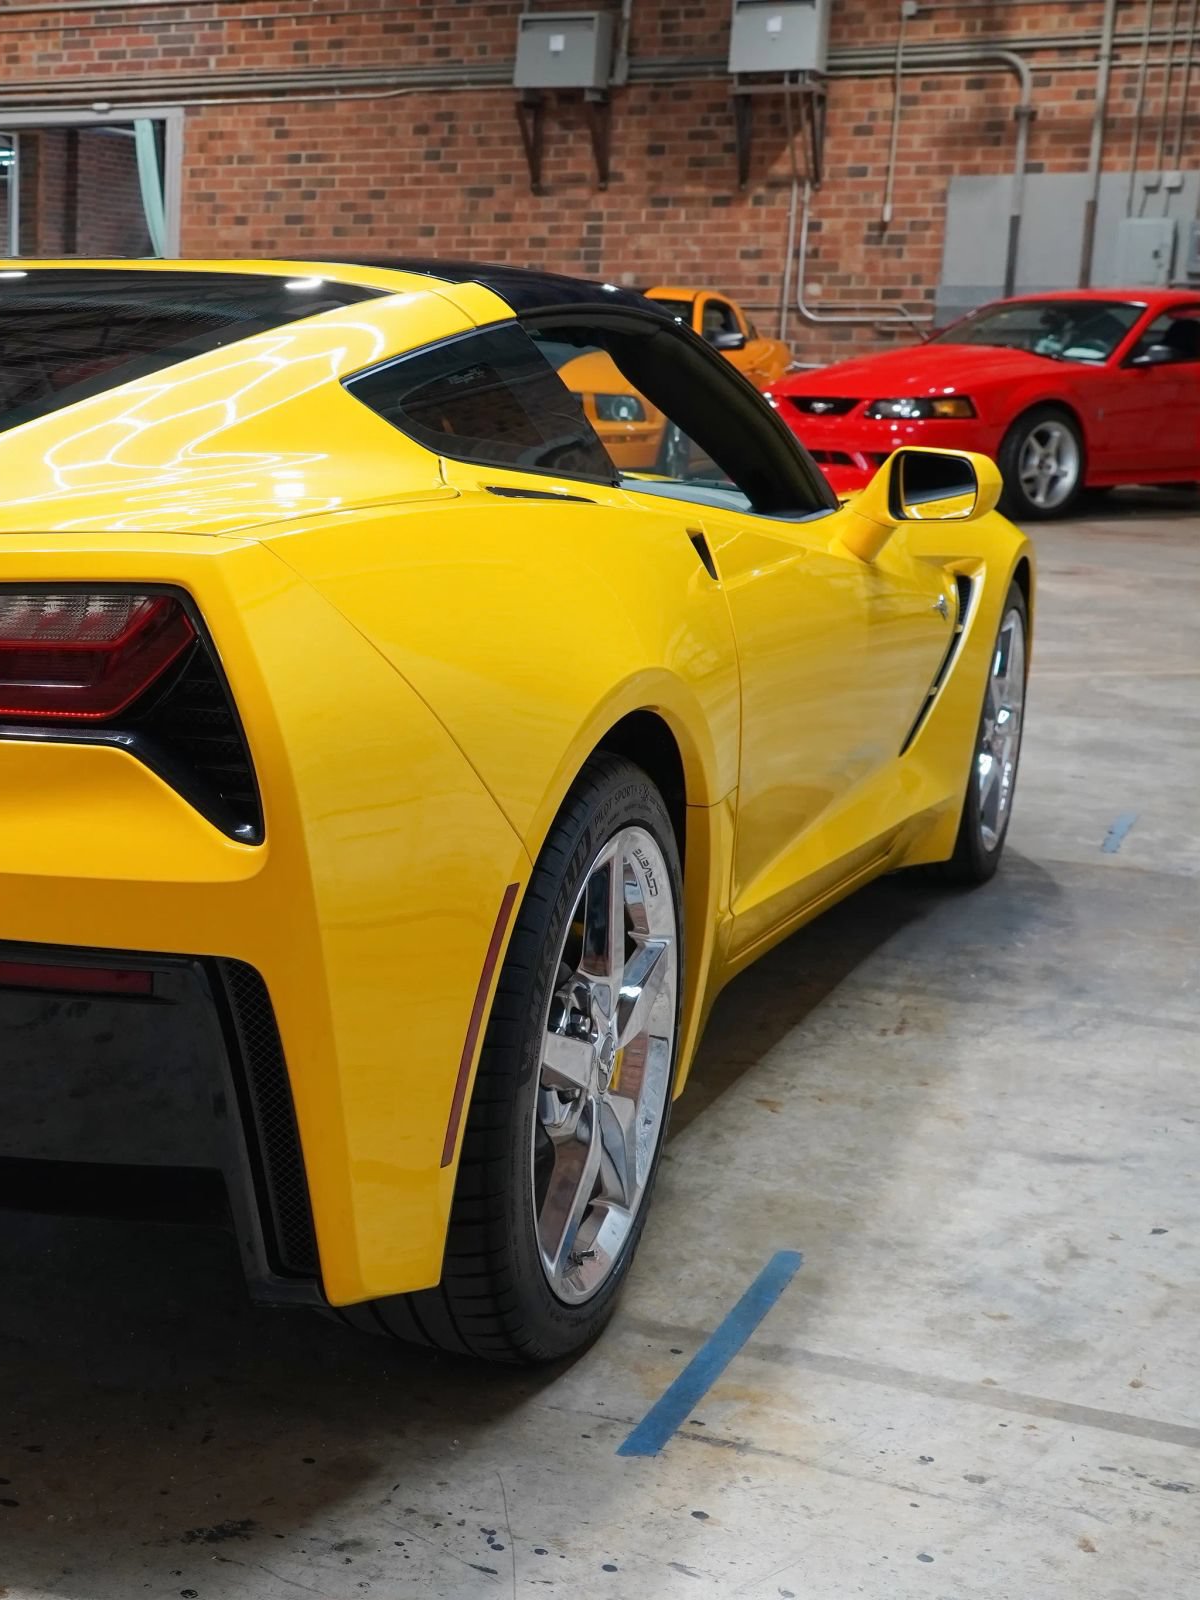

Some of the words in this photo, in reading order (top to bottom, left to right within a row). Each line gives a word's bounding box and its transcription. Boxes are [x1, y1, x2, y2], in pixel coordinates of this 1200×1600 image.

[594, 797, 613, 828] PILOT
[614, 784, 635, 805] SPORT
[632, 848, 659, 897] CORVETTE
[529, 834, 589, 1024] MICHELIN
